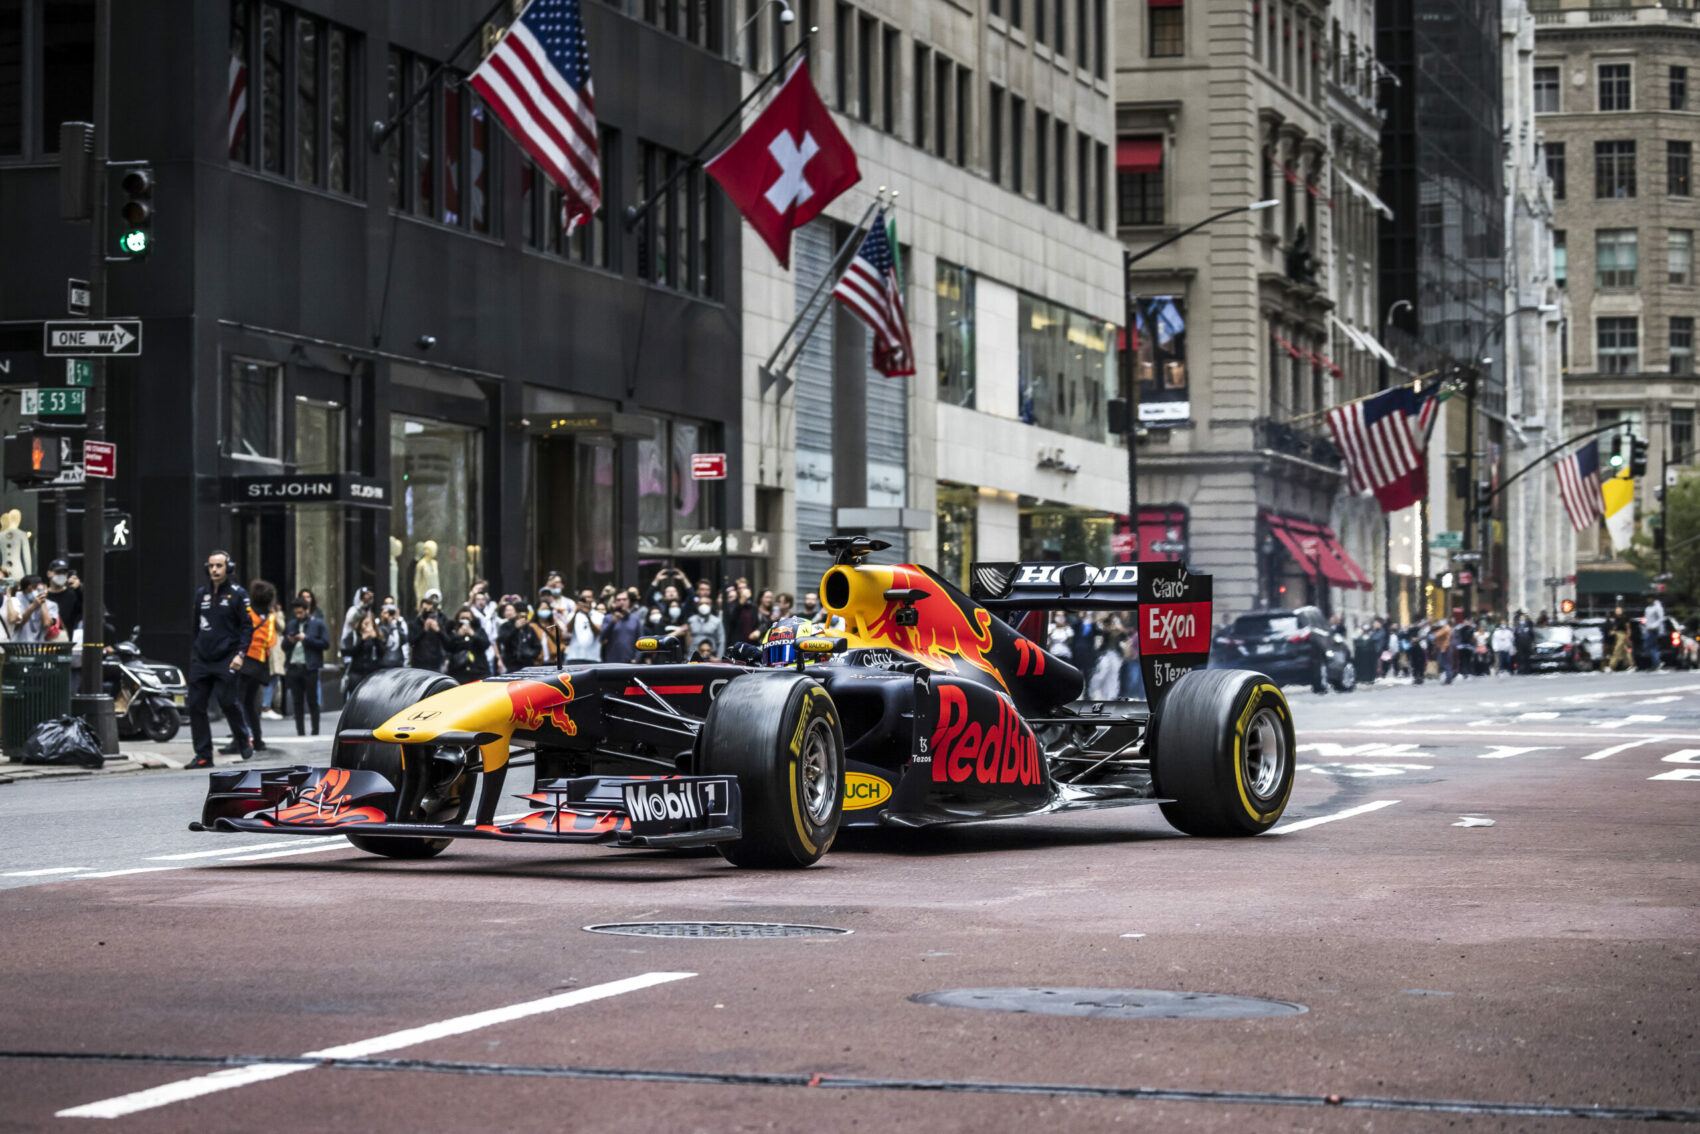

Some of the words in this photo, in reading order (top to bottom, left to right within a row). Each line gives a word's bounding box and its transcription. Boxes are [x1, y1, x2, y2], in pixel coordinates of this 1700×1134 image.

[59, 332, 86, 345] ONE
[98, 332, 126, 345] WAY
[38, 392, 45, 411] E
[50, 392, 66, 411] 53
[275, 483, 332, 496] JOHN
[1149, 607, 1195, 649] Exxon
[808, 641, 831, 650] RAUCH
[1013, 637, 1046, 677] 11
[931, 684, 1005, 784] Red
[1000, 699, 1041, 786] Bull
[912, 754, 932, 763] Tezos
[844, 782, 880, 799] UCH
[625, 782, 698, 822] Mobil
[704, 783, 715, 809] 1
